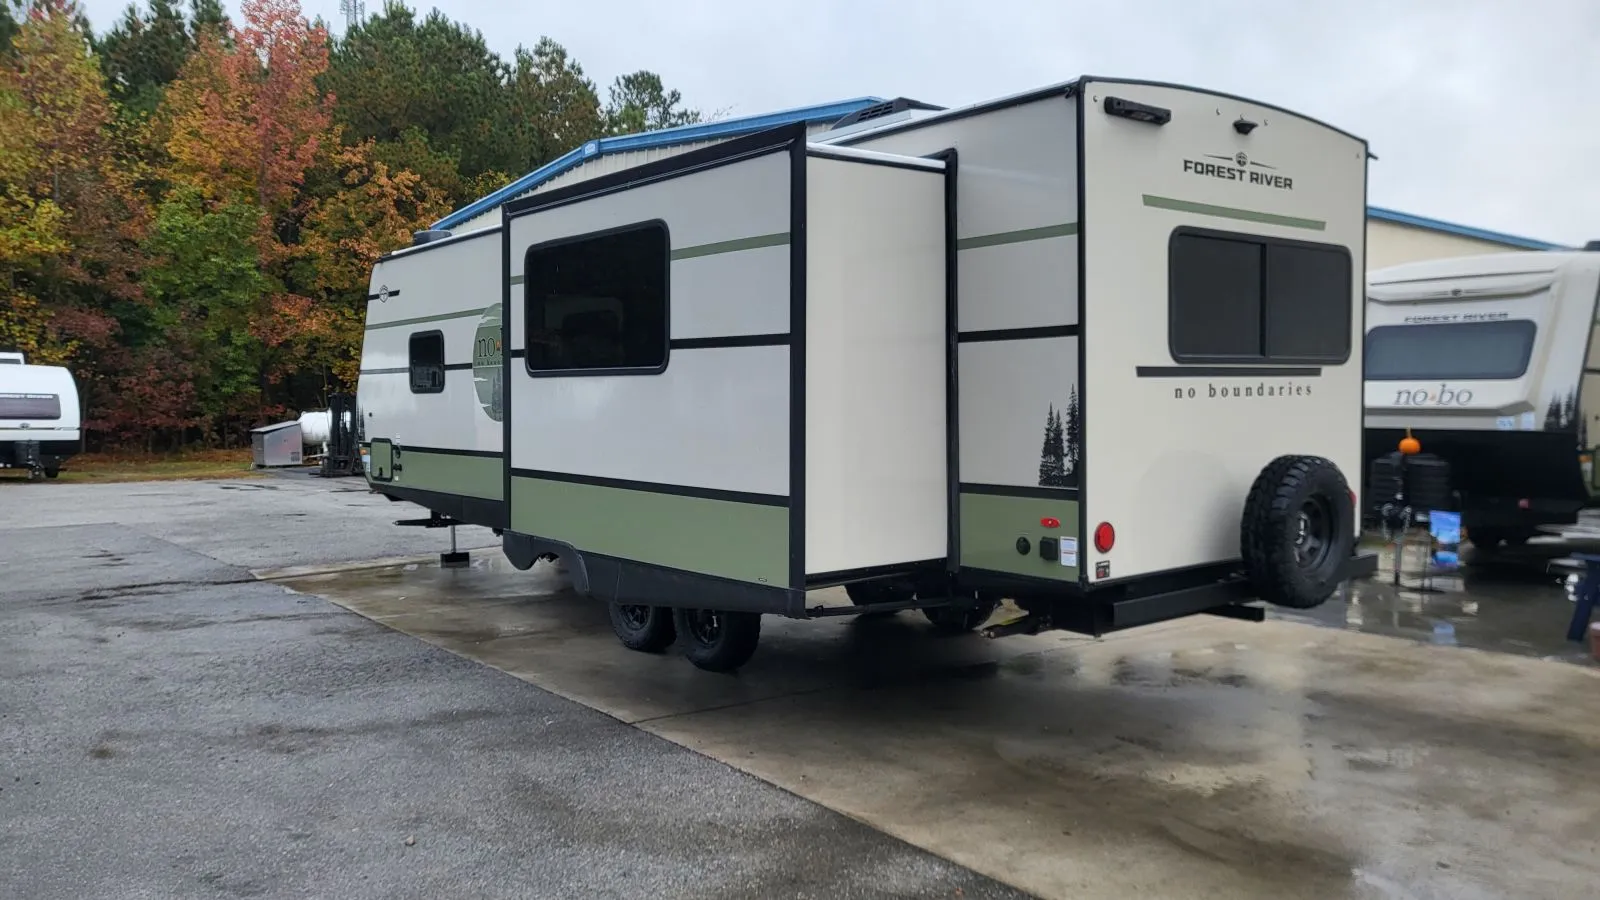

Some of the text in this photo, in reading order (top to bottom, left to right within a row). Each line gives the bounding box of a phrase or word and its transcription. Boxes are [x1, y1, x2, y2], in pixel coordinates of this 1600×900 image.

[1183, 159, 1293, 190] FOREST RIVER
[1174, 382, 1312, 399] no boundaries
